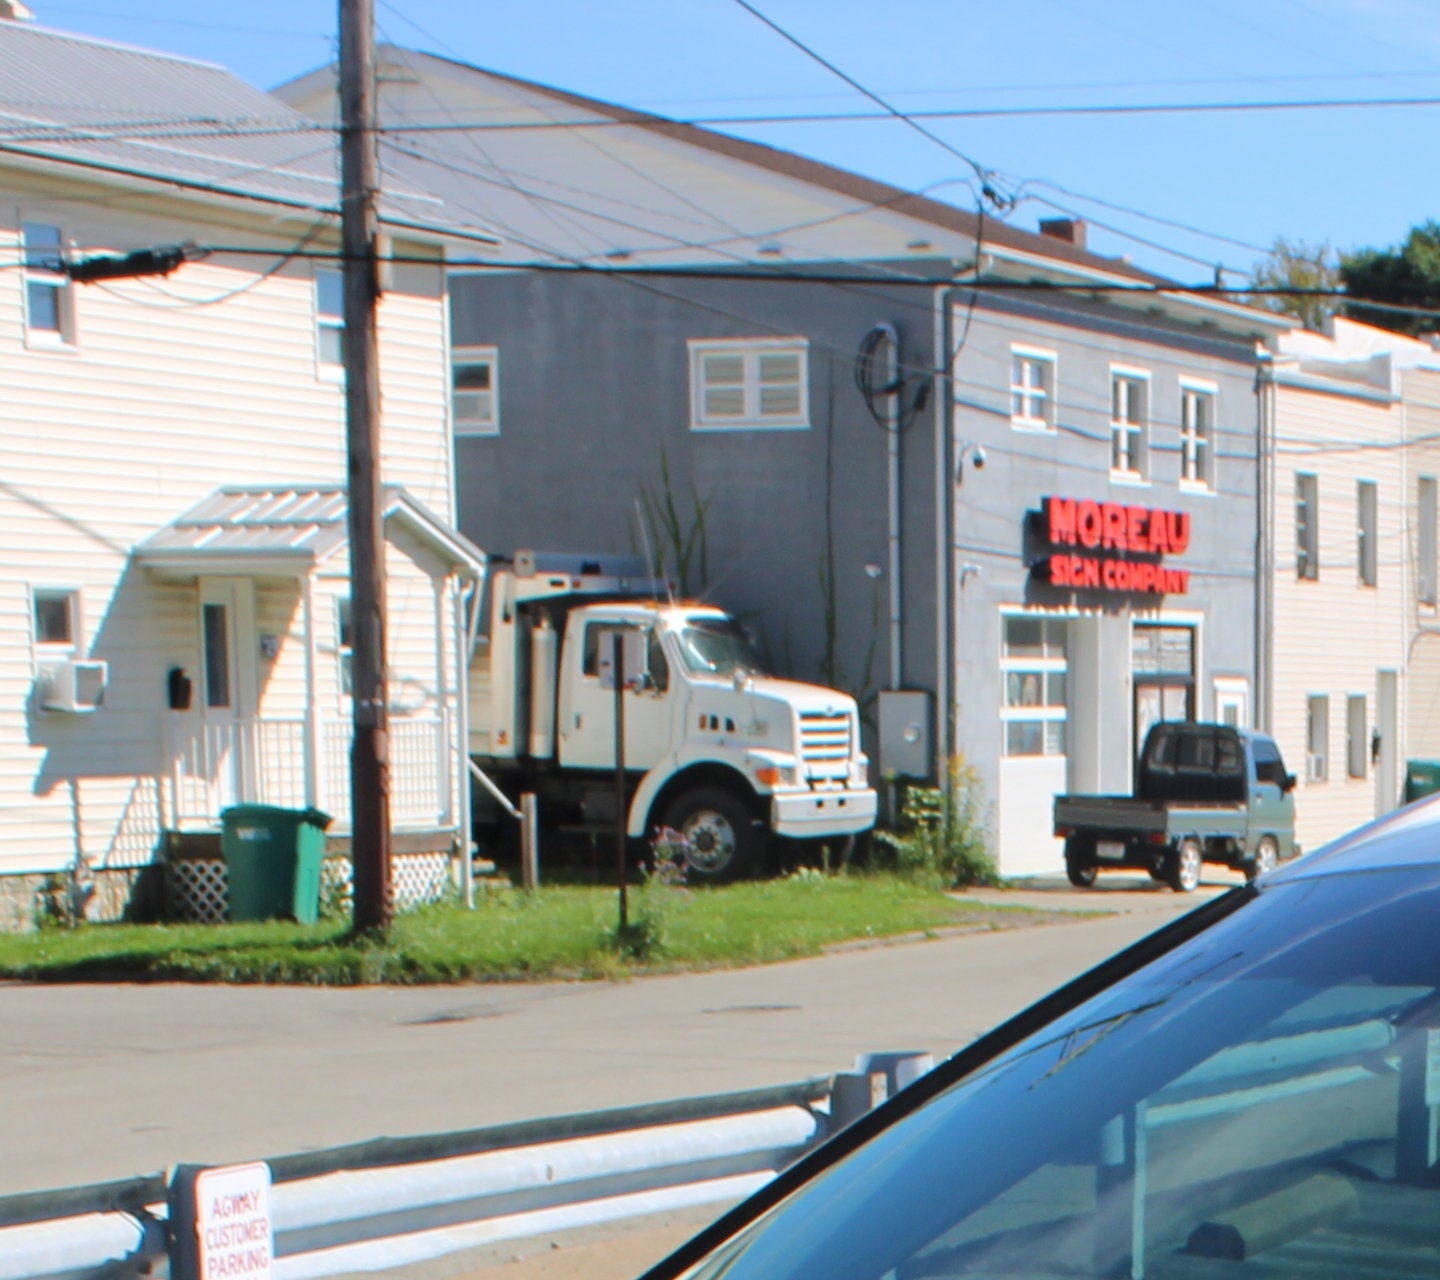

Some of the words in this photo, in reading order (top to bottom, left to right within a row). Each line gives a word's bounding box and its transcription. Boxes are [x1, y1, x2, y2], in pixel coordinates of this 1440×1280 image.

[1048, 495, 1192, 555] MOREAU
[1049, 554, 1101, 588] SIGN
[1102, 559, 1192, 595] COMPANY
[211, 1189, 261, 1219] AGWAY
[205, 1219, 269, 1250] CUSTOMER
[207, 1249, 269, 1280] PARKING
